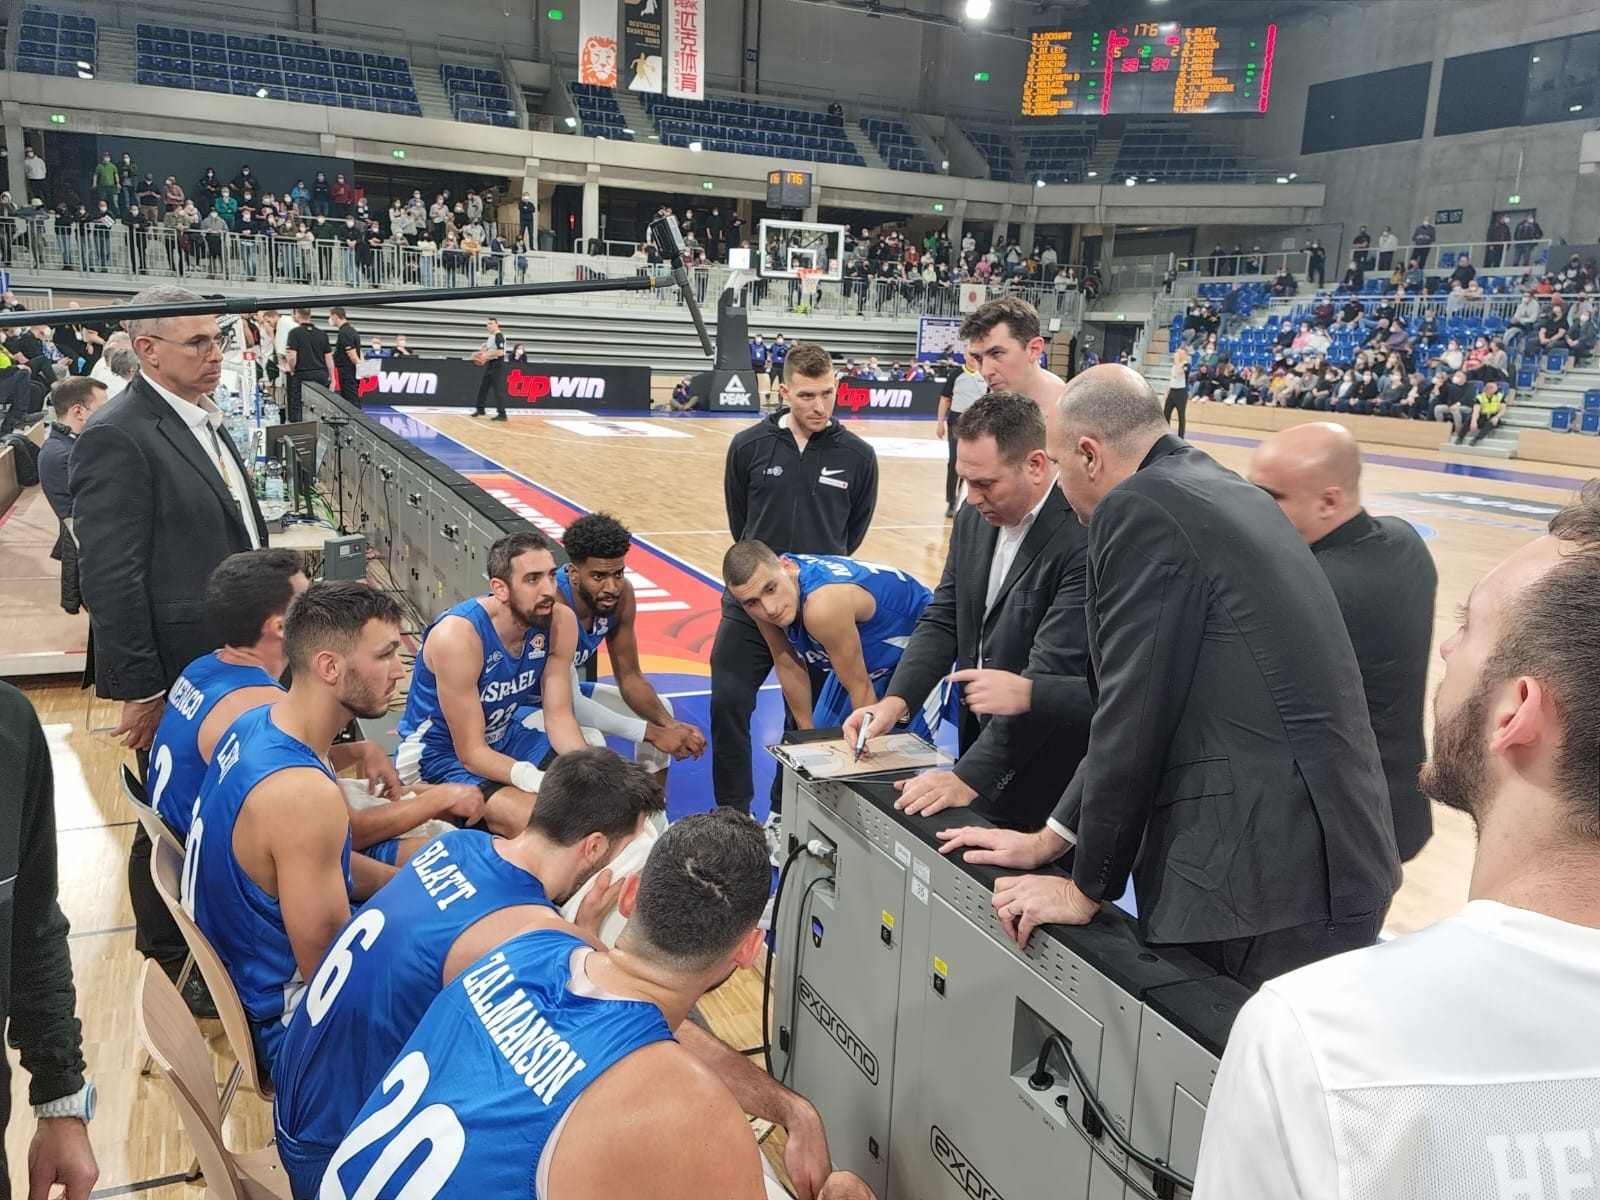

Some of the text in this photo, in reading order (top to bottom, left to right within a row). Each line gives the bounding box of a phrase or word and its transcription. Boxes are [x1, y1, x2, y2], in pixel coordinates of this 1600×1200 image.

[680, 11, 698, 93] 匹克体育
[1151, 57, 1170, 71] 34
[1170, 45, 1180, 57] 2
[506, 369, 605, 402] tipwin
[719, 392, 752, 406] PEAK
[837, 382, 912, 411] tipwin
[485, 702, 518, 731] 23
[147, 735, 173, 814] 2
[411, 840, 477, 912] BLATT
[306, 908, 386, 1027] 6
[461, 952, 586, 1106] ZALMANSON
[799, 980, 877, 1080] expromo
[319, 1050, 466, 1200] 20
[936, 1134, 999, 1200] expr
